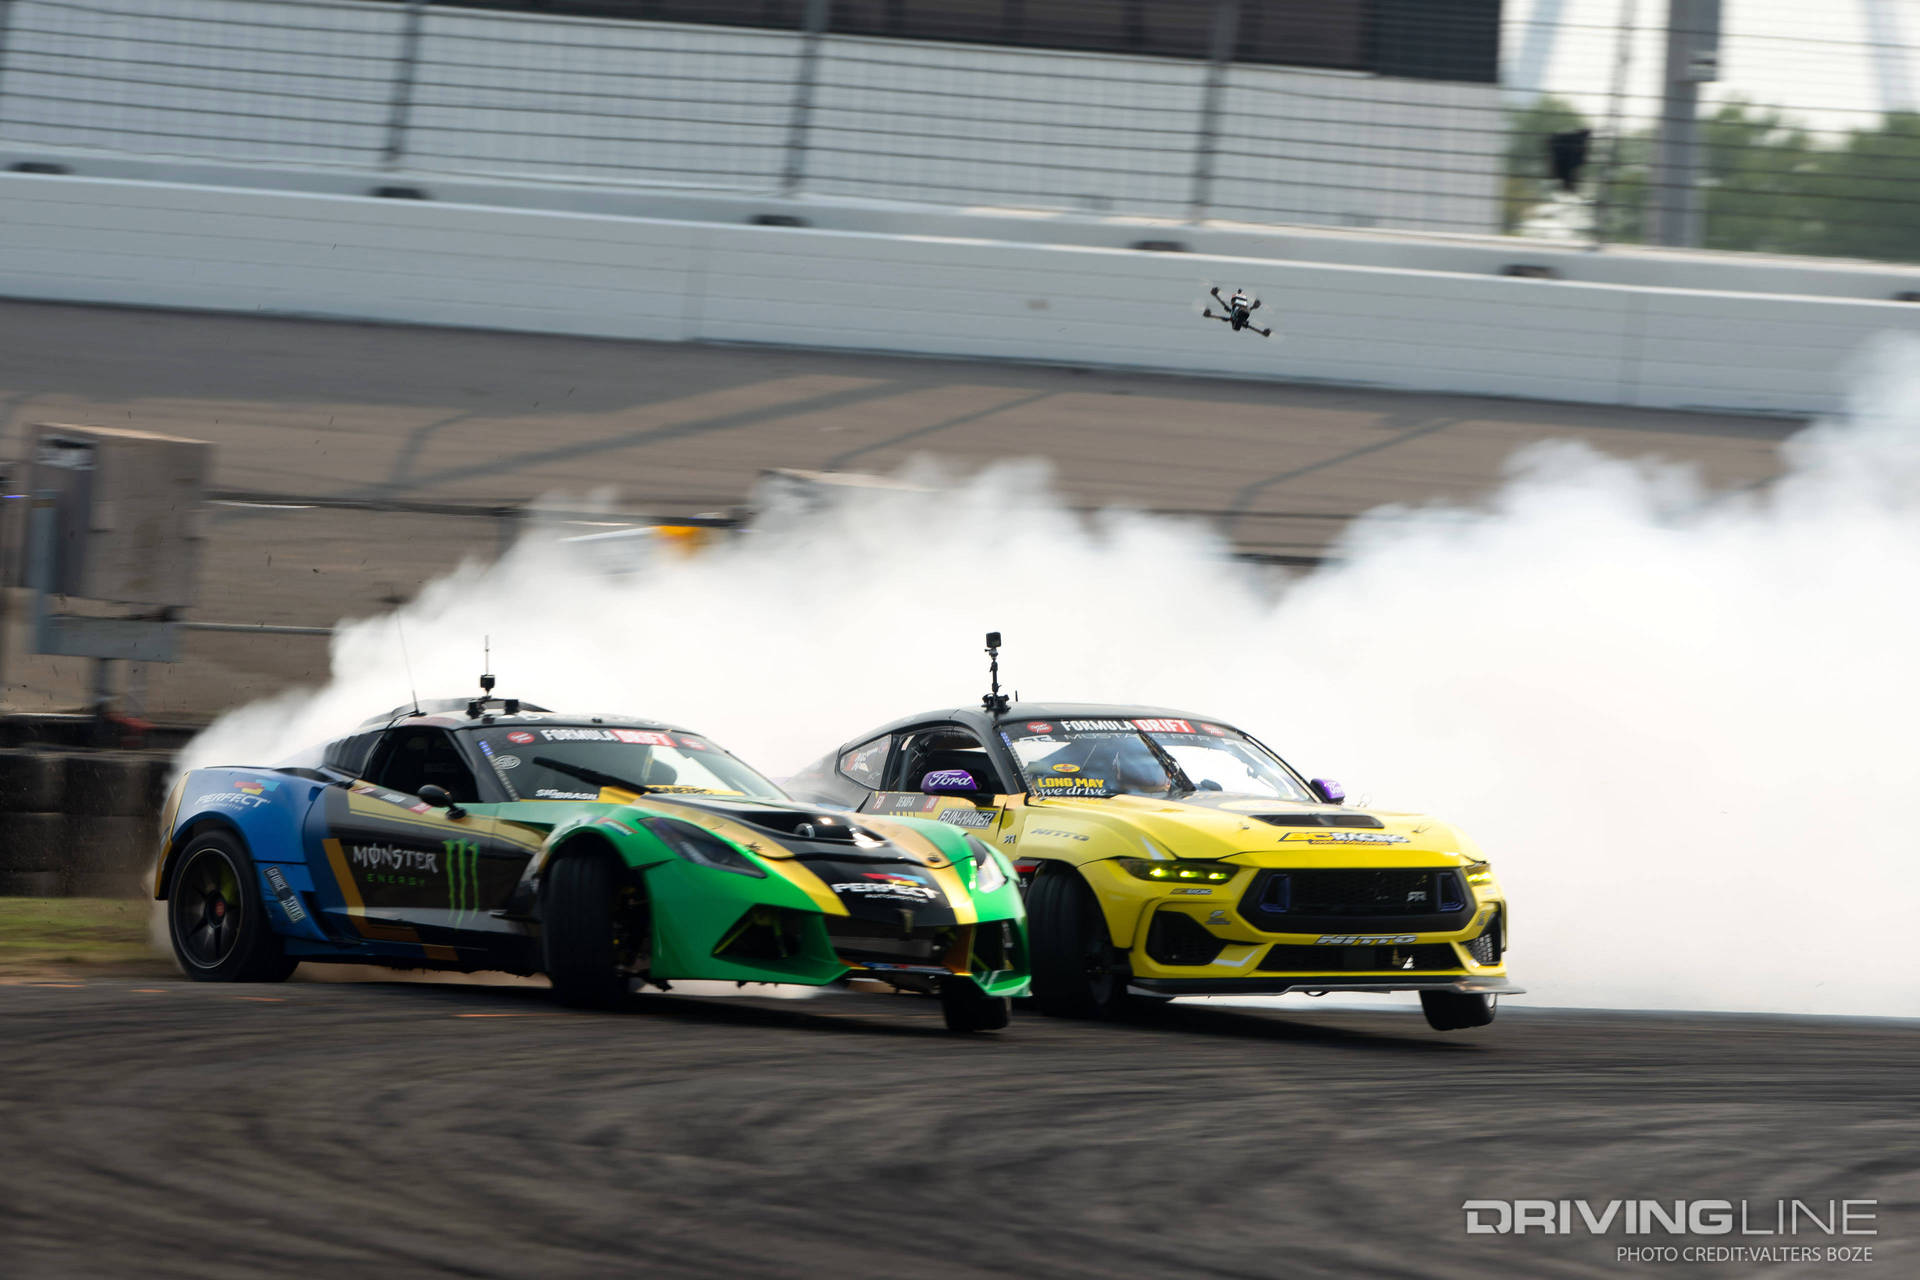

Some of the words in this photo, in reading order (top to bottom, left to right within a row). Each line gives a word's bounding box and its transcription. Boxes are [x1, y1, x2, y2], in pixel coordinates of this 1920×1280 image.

[1061, 719, 1138, 732] FORMULA
[1136, 719, 1190, 733] DRIFT
[541, 729, 620, 742] FORMULA
[928, 771, 971, 787] Ford
[1075, 778, 1105, 789] MAY
[1041, 787, 1064, 797] we
[1066, 785, 1107, 796] drive
[939, 809, 994, 827] FUN-HAVER
[353, 843, 439, 873] MONSTER
[367, 873, 426, 887] ENERGY
[831, 883, 940, 899] PERFECT
[1316, 935, 1418, 945] NITTO
